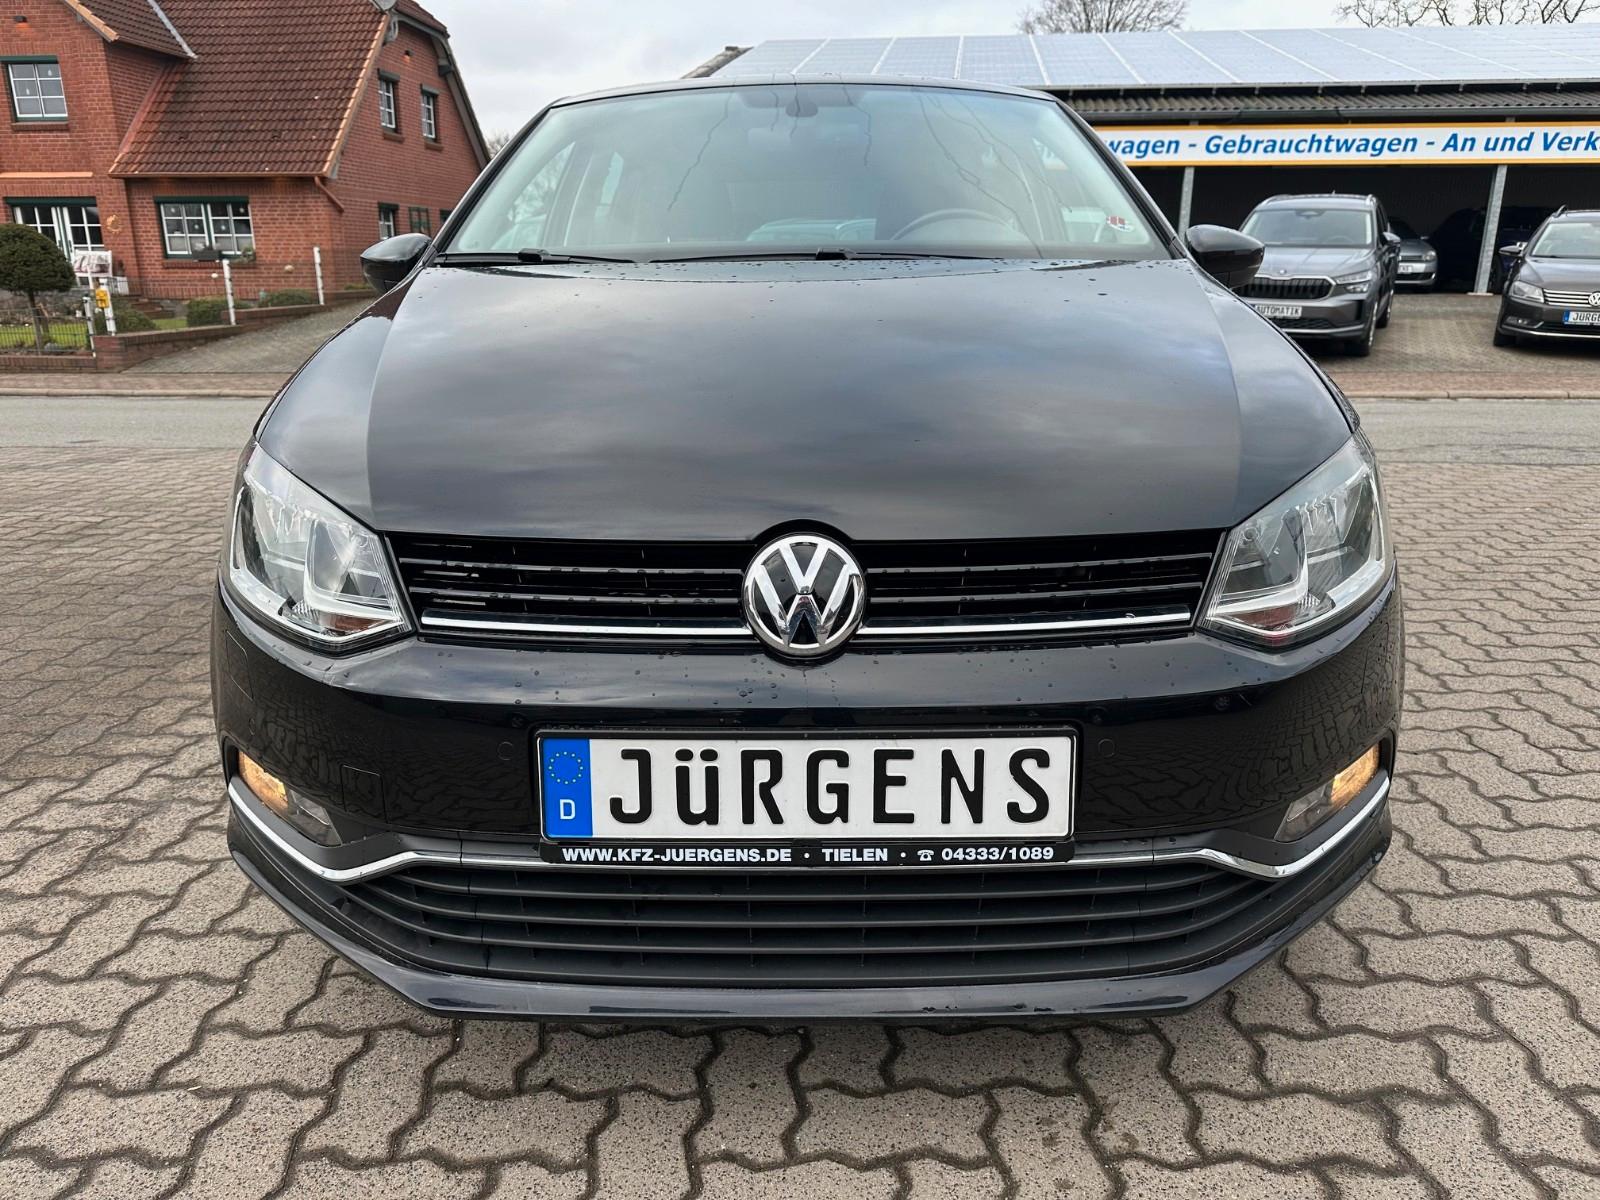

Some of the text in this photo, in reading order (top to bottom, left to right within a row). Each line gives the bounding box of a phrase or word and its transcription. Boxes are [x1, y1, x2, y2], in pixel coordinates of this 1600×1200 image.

[1205, 133, 1418, 158] Gebrauchtwagen
[1441, 132, 1477, 152] An
[1483, 131, 1535, 152] und
[559, 798, 576, 820] D
[562, 846, 1054, 863] WWW.KFZ-JUERGENS.DE TIELEN 04333/1089
